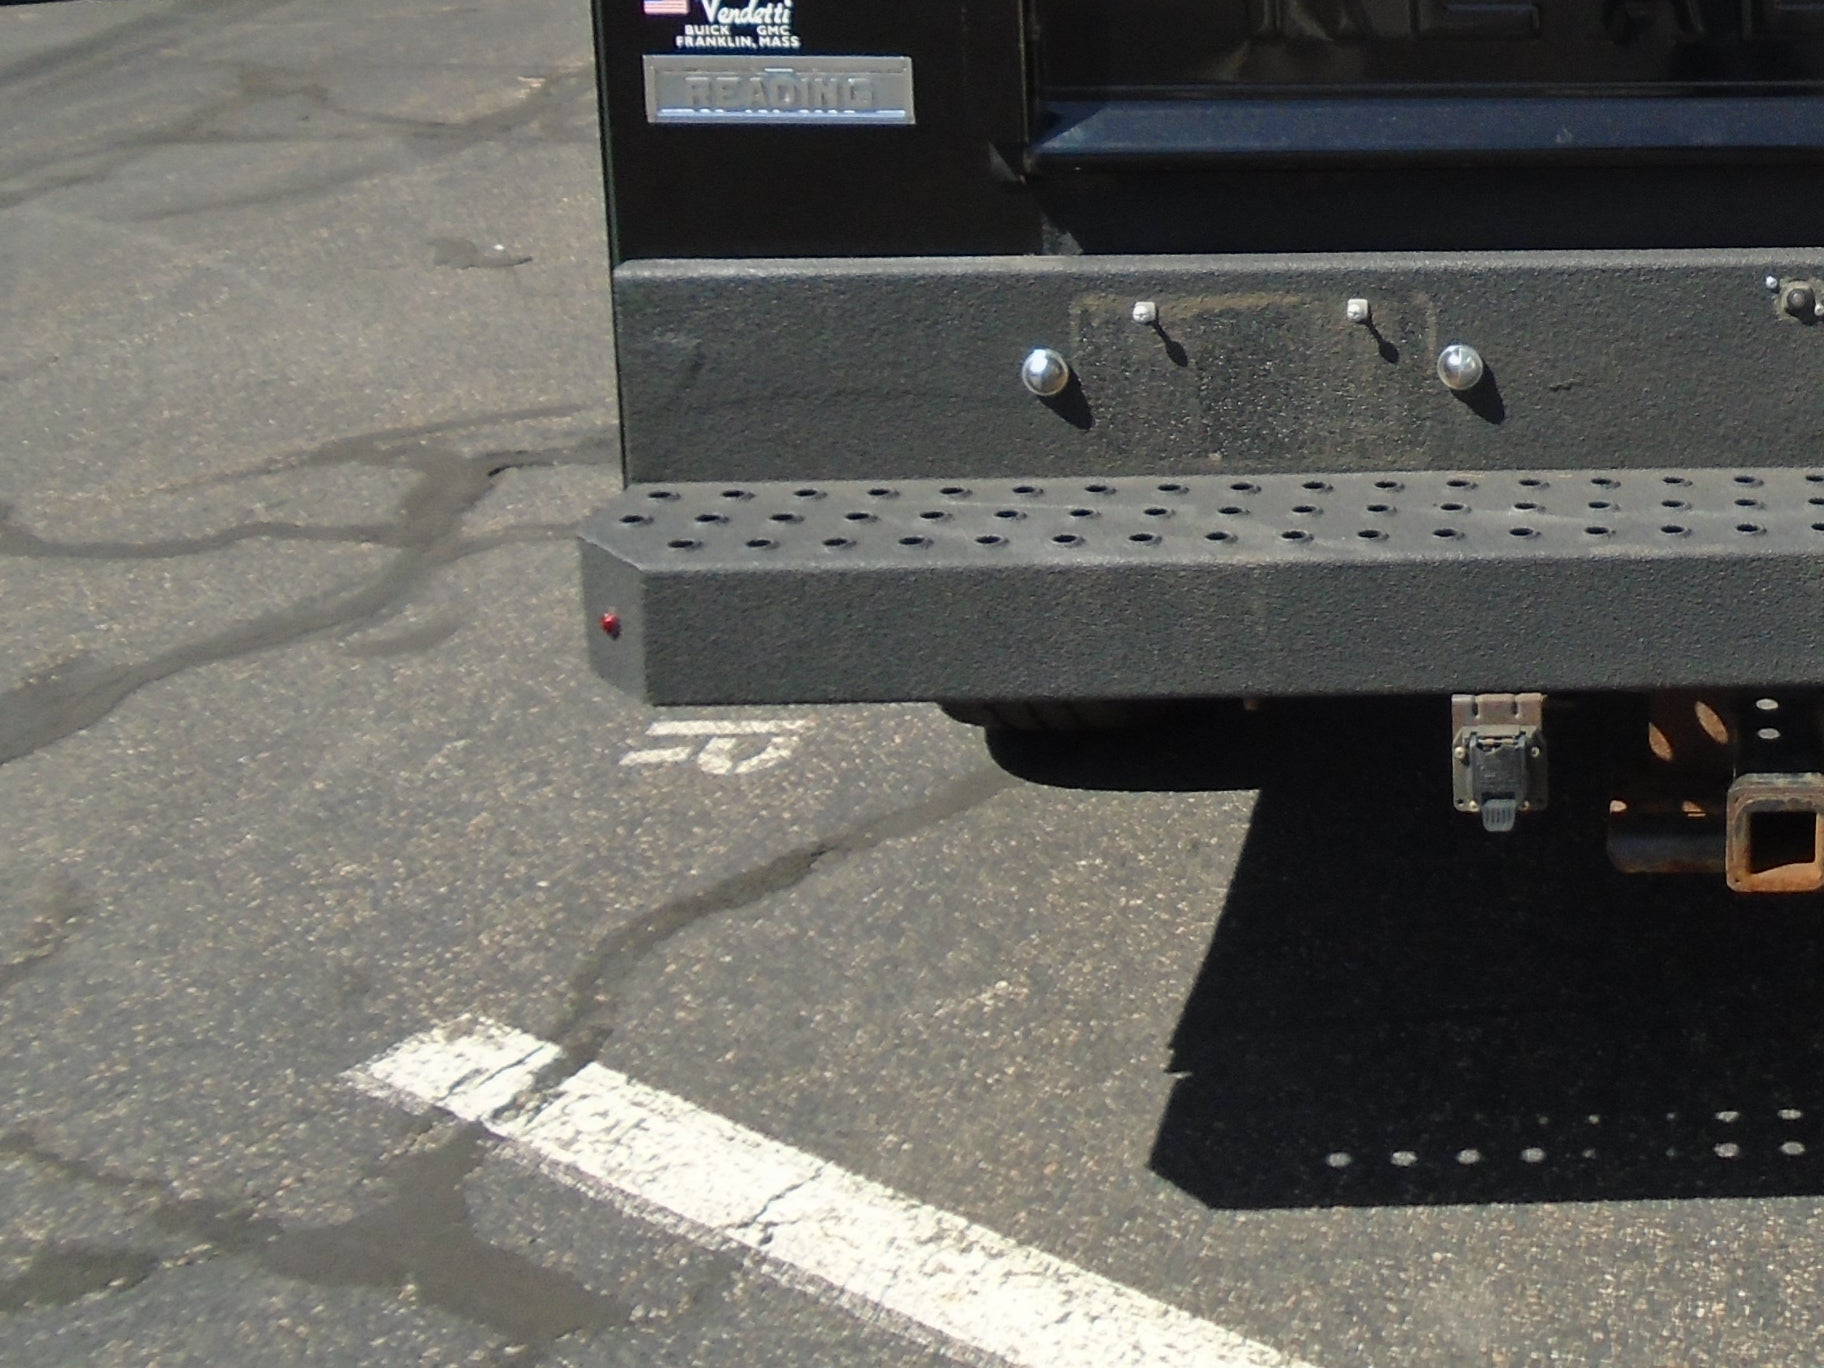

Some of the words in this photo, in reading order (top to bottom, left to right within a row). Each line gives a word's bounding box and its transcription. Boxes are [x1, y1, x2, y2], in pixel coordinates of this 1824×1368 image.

[685, 24, 730, 36] BUICK
[757, 25, 790, 37] GMC
[676, 35, 758, 49] FRANKLIN,
[684, 69, 873, 112] READING
